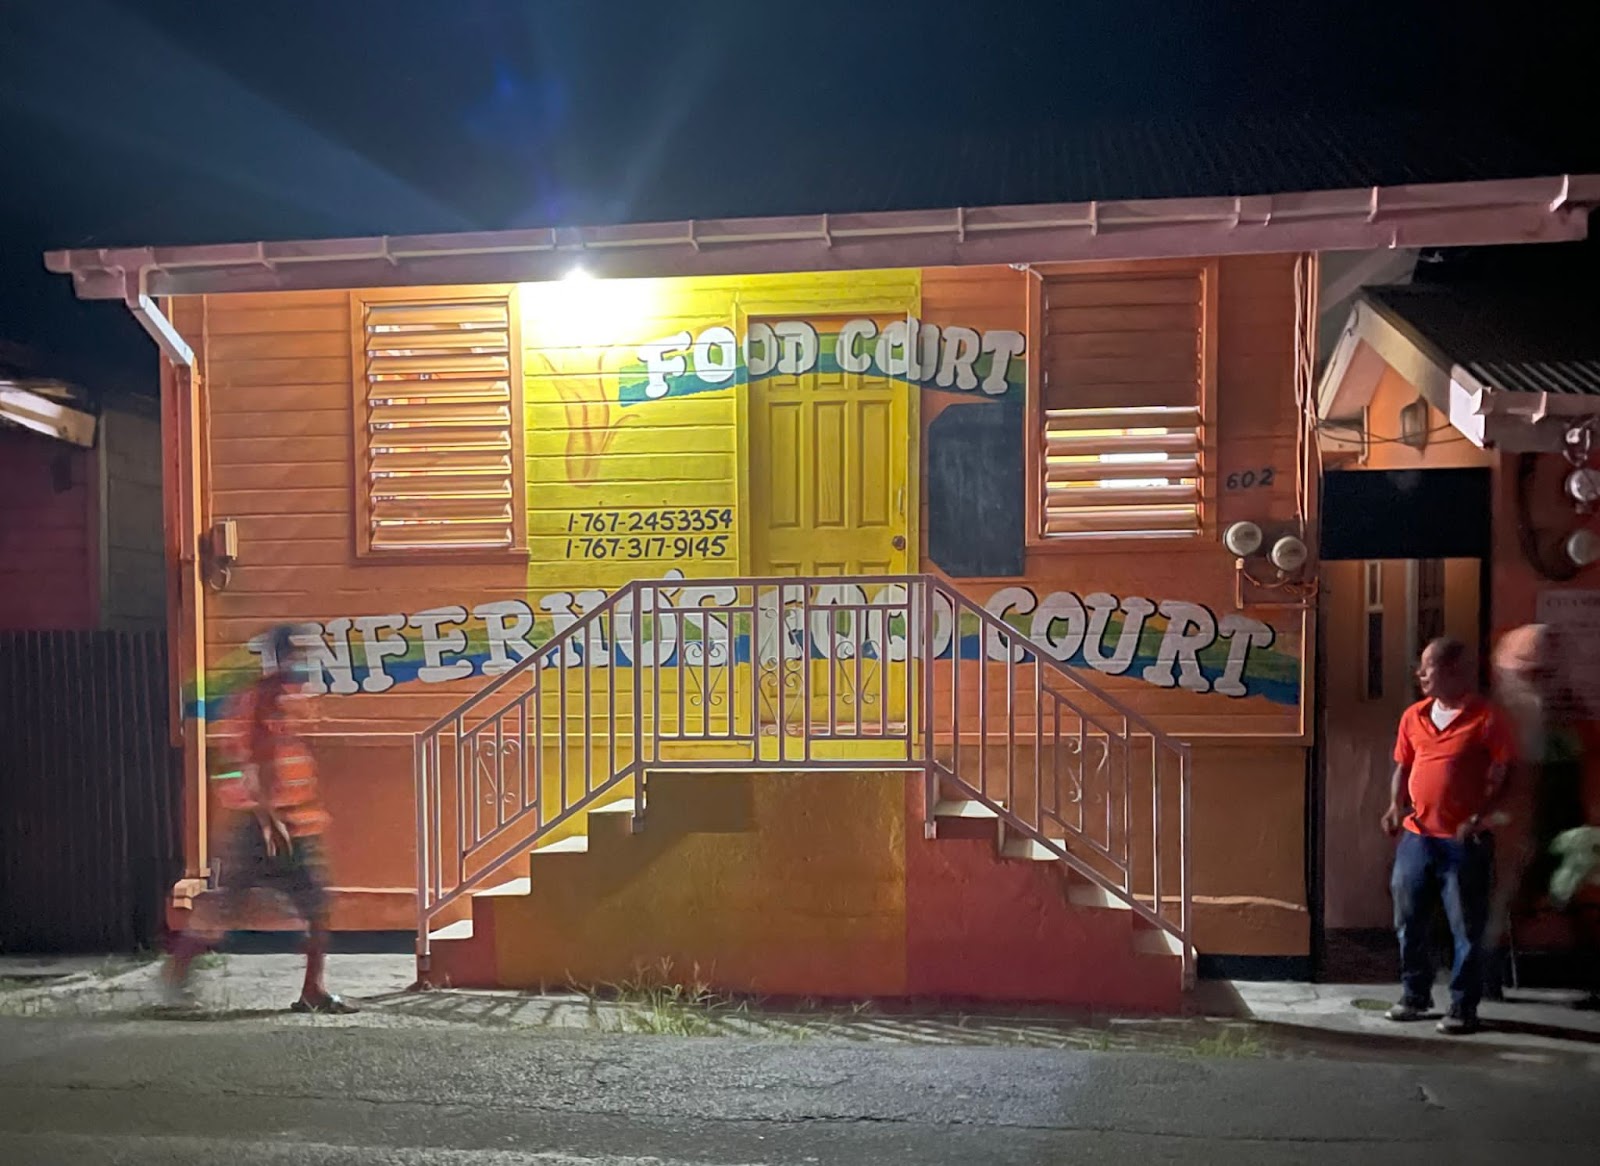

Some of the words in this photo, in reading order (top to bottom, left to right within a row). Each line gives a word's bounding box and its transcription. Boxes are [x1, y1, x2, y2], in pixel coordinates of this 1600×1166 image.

[637, 320, 819, 399] FOOD
[835, 317, 1026, 397] COURT
[1226, 468, 1275, 491] 602
[565, 535, 730, 559] 1-767-317-9145
[984, 587, 1276, 699] COURT
